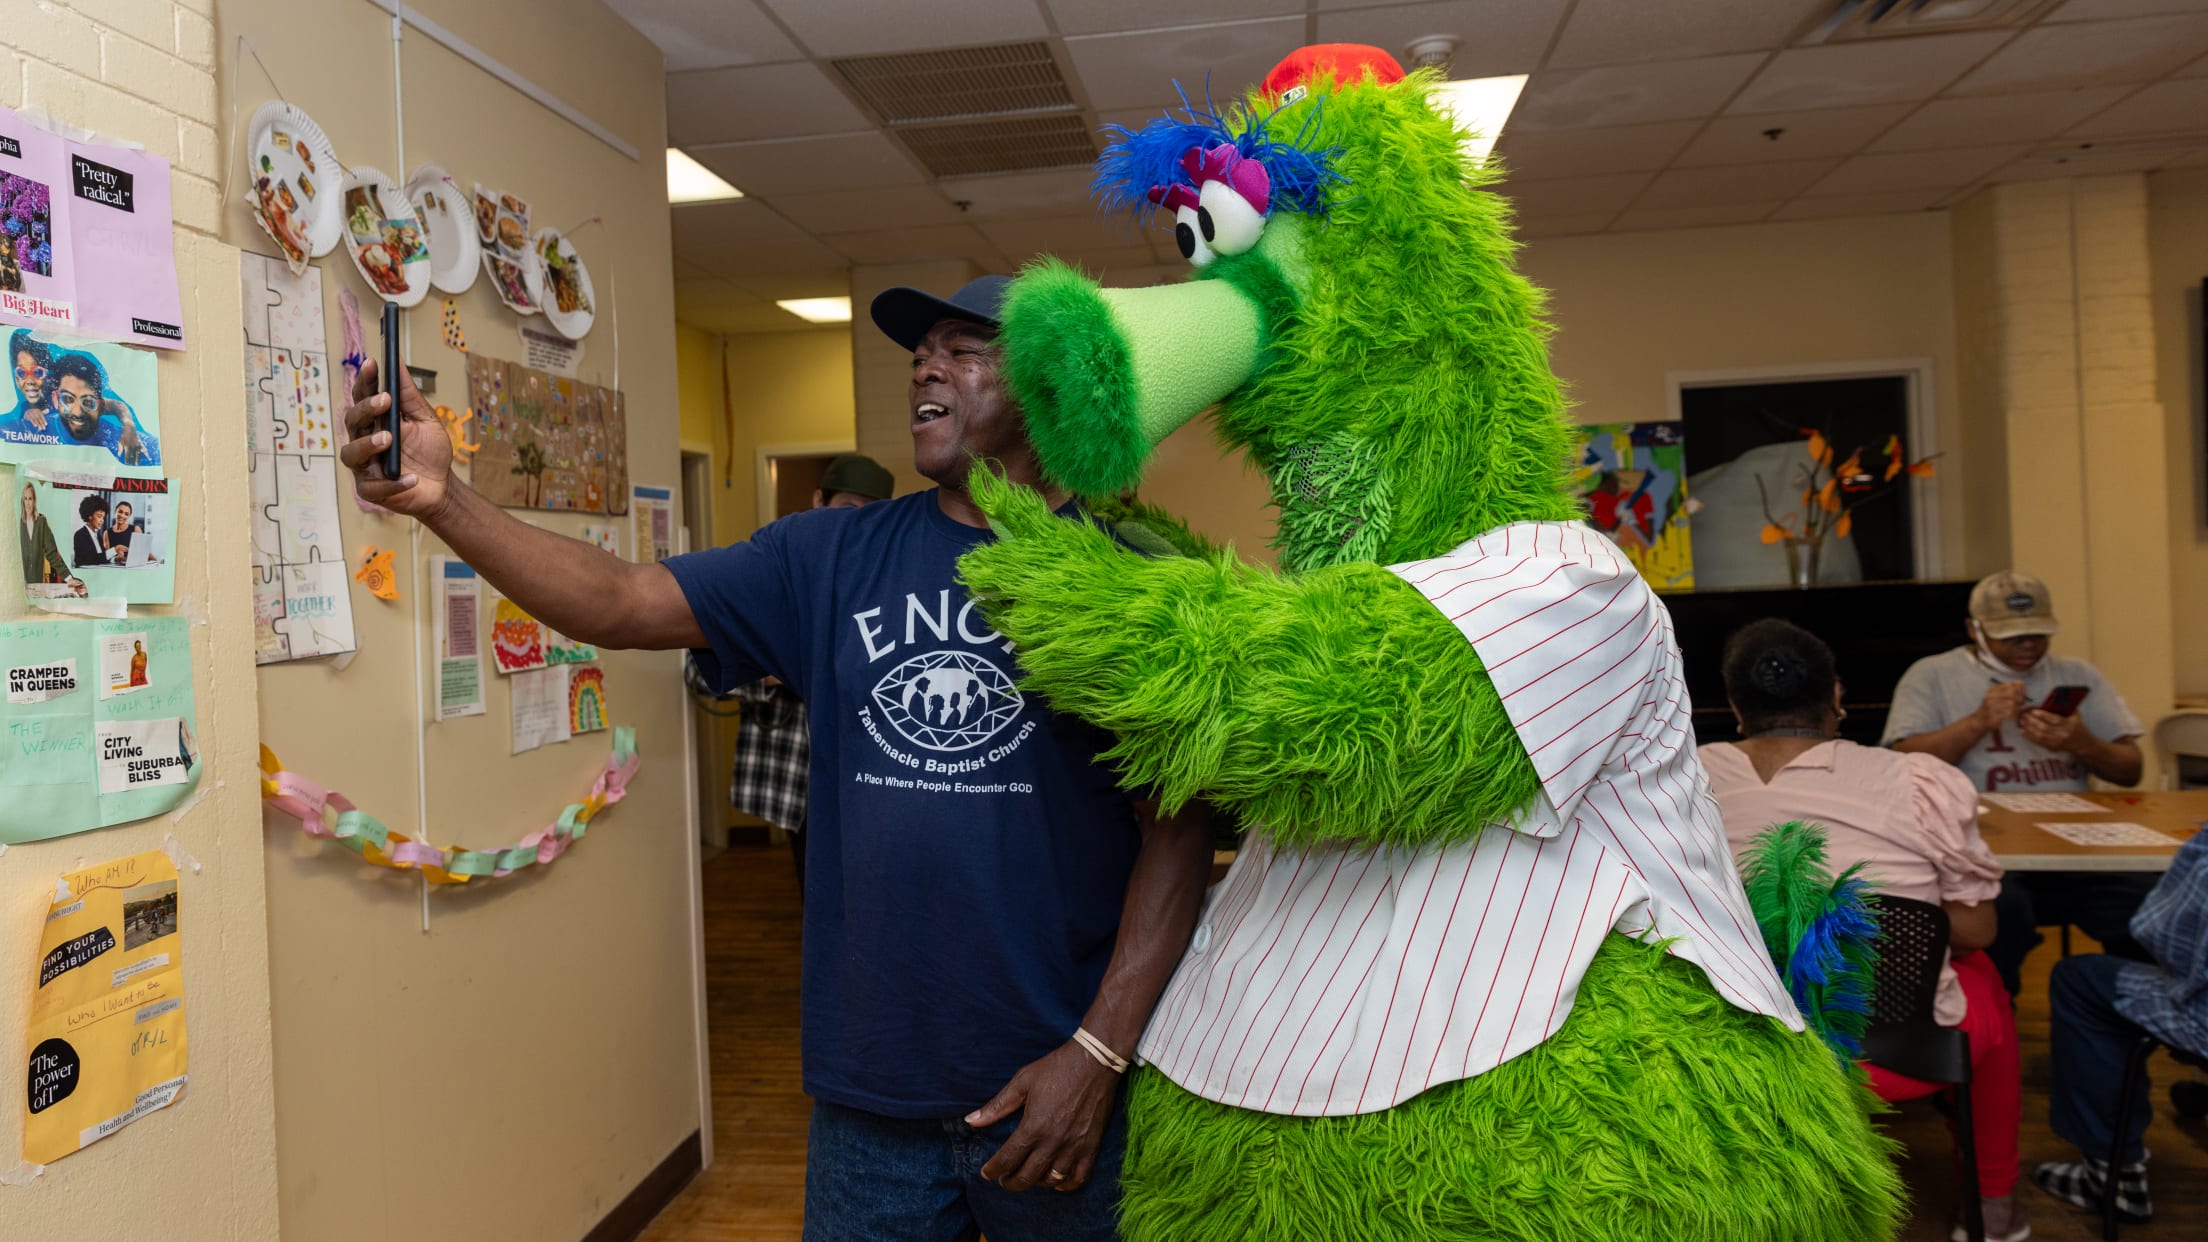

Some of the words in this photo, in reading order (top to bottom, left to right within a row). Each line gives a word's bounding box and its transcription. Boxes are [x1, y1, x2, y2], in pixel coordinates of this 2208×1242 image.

[3, 293, 27, 315] Big
[29, 299, 70, 320] Heart
[134, 320, 182, 338] Professional
[9, 666, 69, 680] CRAMPED
[10, 681, 24, 692] IN
[28, 678, 76, 692] QUEENS
[10, 721, 41, 737] THE
[21, 732, 85, 756] WINNER
[104, 737, 131, 748] CITY
[857, 705, 920, 768] Tabernacle
[925, 756, 986, 776] Baptist
[988, 720, 1036, 763] Church
[104, 747, 142, 760] LIVING
[129, 770, 161, 783] BLISS
[855, 773, 863, 783] A
[864, 773, 883, 786] Place
[885, 776, 914, 789] Where
[916, 780, 951, 793] People
[955, 782, 1007, 793] Encounter
[1009, 782, 1033, 794] GOD
[42, 937, 114, 984] POSSIBILITIES
[43, 951, 63, 971] FIND
[66, 933, 96, 954] YOUR
[35, 1063, 74, 1094] power
[136, 1088, 153, 1104] Good
[153, 1076, 186, 1096] Personal
[98, 1116, 122, 1136] Health
[122, 1110, 135, 1123] and
